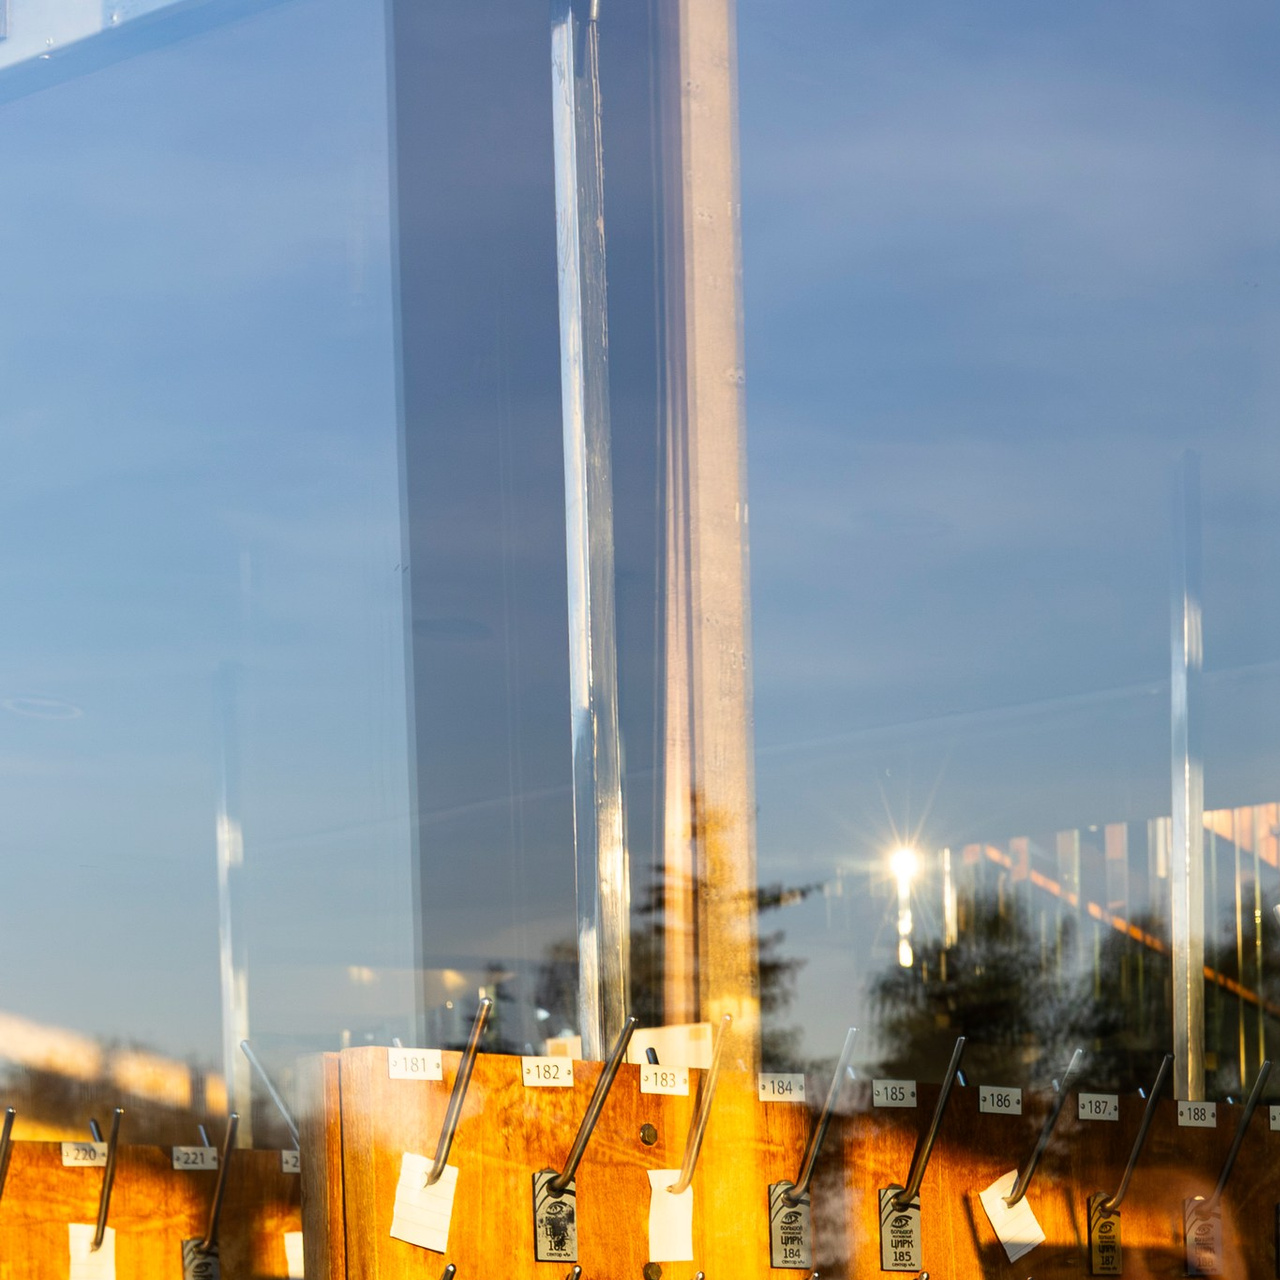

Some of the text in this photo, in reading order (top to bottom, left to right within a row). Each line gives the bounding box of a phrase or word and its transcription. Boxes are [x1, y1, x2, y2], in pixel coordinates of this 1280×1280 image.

[403, 1057, 427, 1073] 181
[536, 1065, 559, 1080] 182
[654, 1072, 676, 1088] 183
[770, 1080, 792, 1095] 184
[884, 1086, 905, 1101] 185
[990, 1093, 1011, 1108] 186
[1088, 1100, 1108, 1114] 187
[1187, 1107, 1206, 1122] 188
[74, 1148, 97, 1161] 220
[184, 1152, 204, 1165] 221
[780, 1236, 804, 1247] ЦИРК
[891, 1239, 914, 1249] ЦИРК
[783, 1248, 800, 1259] 184
[893, 1251, 911, 1262] 185
[1101, 1256, 1114, 1266] 187
